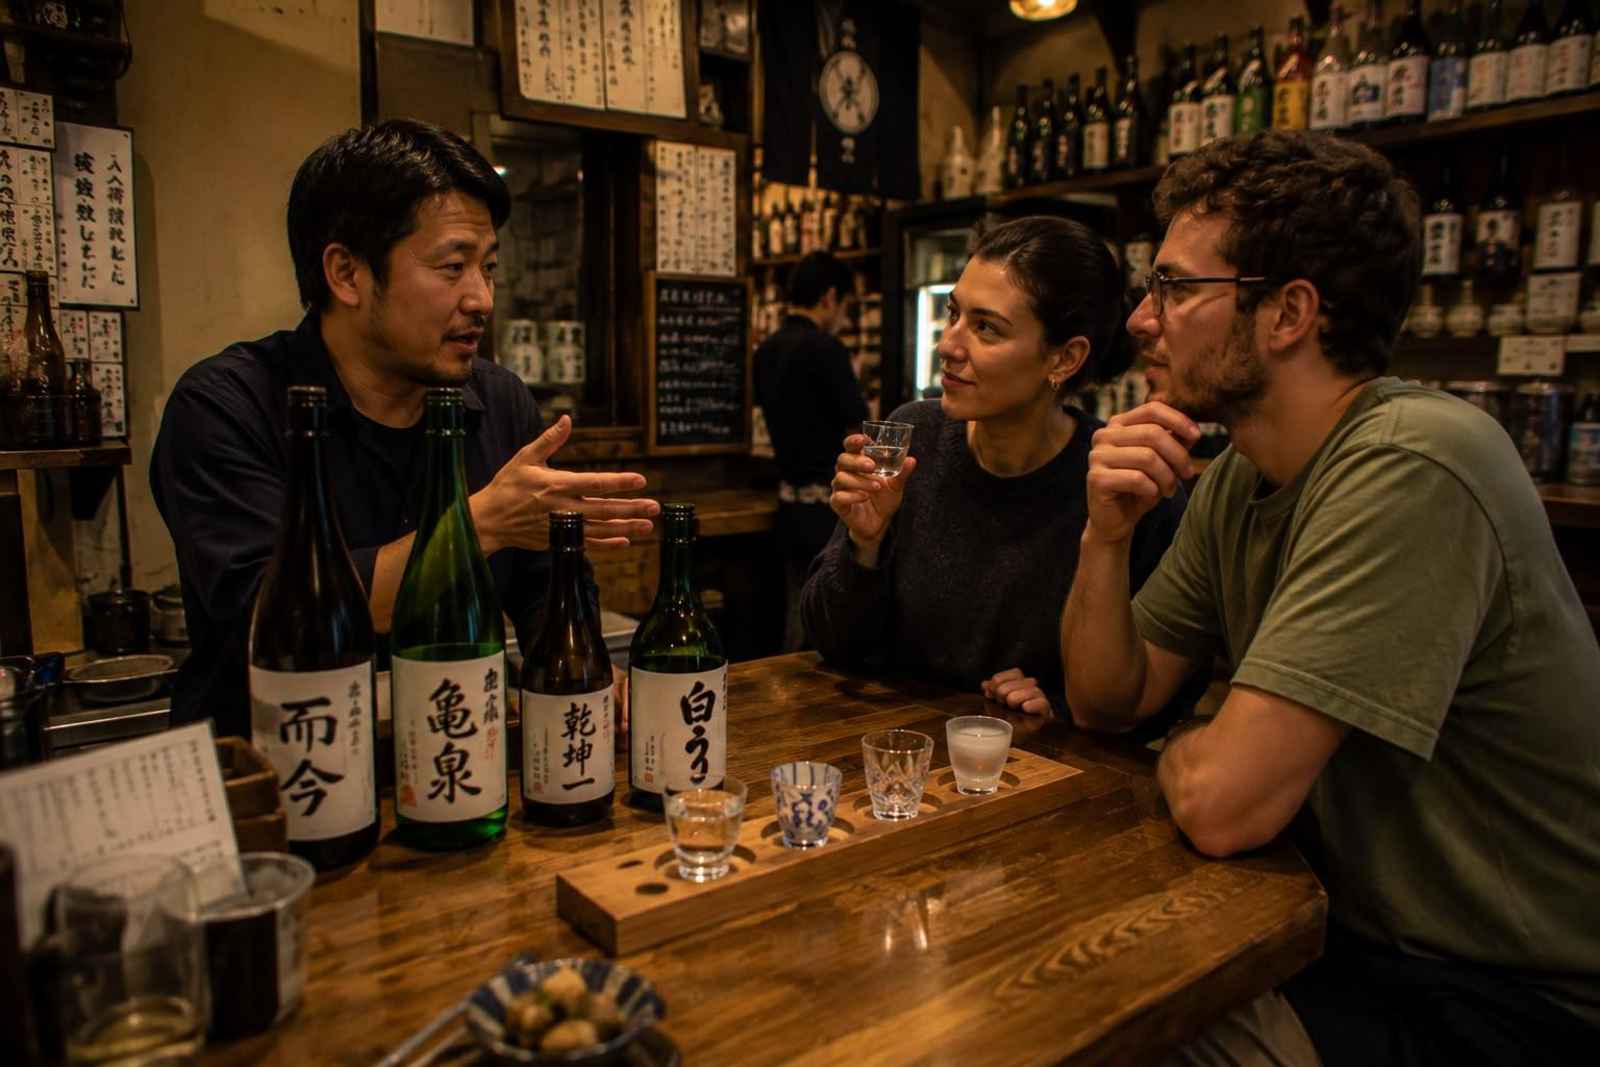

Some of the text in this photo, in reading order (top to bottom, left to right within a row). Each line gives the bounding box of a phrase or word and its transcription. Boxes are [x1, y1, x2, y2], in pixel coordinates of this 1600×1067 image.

[279, 696, 345, 817] 而今
[427, 677, 481, 803] 亀泉
[560, 702, 597, 791] 乾坤一
